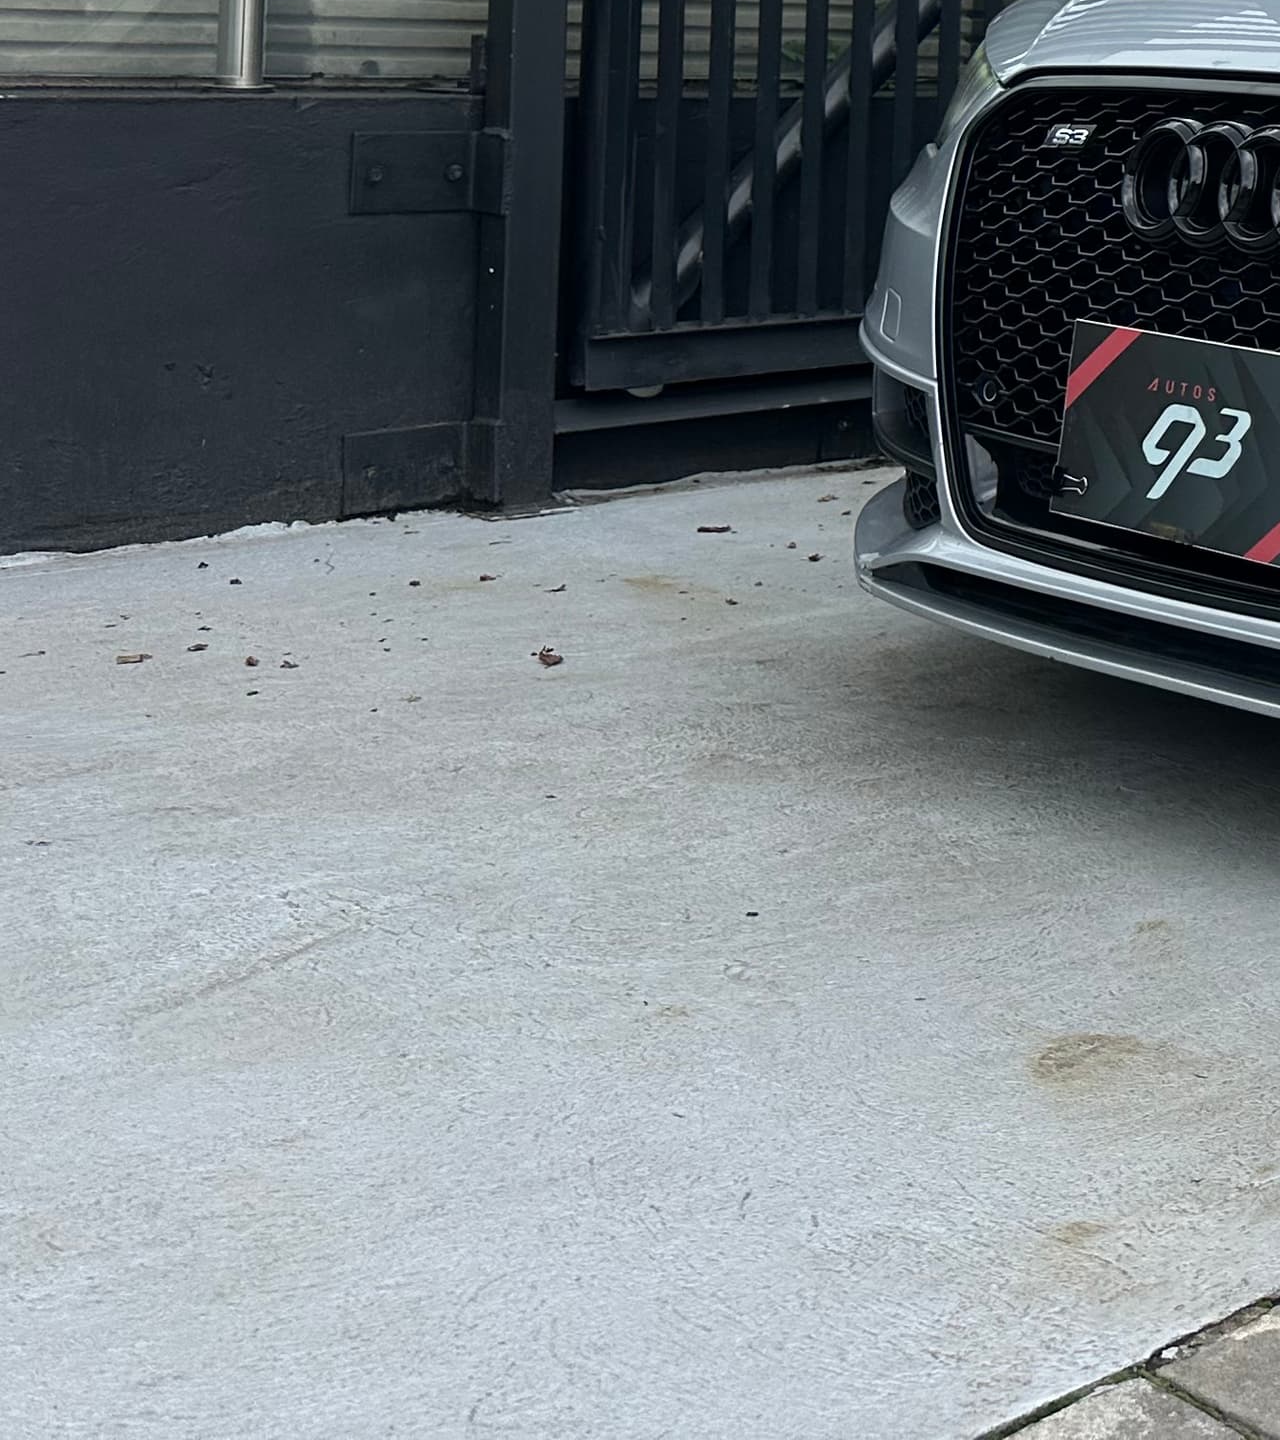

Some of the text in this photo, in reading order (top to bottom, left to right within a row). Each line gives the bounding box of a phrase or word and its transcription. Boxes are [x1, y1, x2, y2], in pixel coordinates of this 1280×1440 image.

[1052, 128, 1089, 145] S3
[1147, 377, 1217, 402] AUTOS
[1142, 403, 1252, 500] 93
